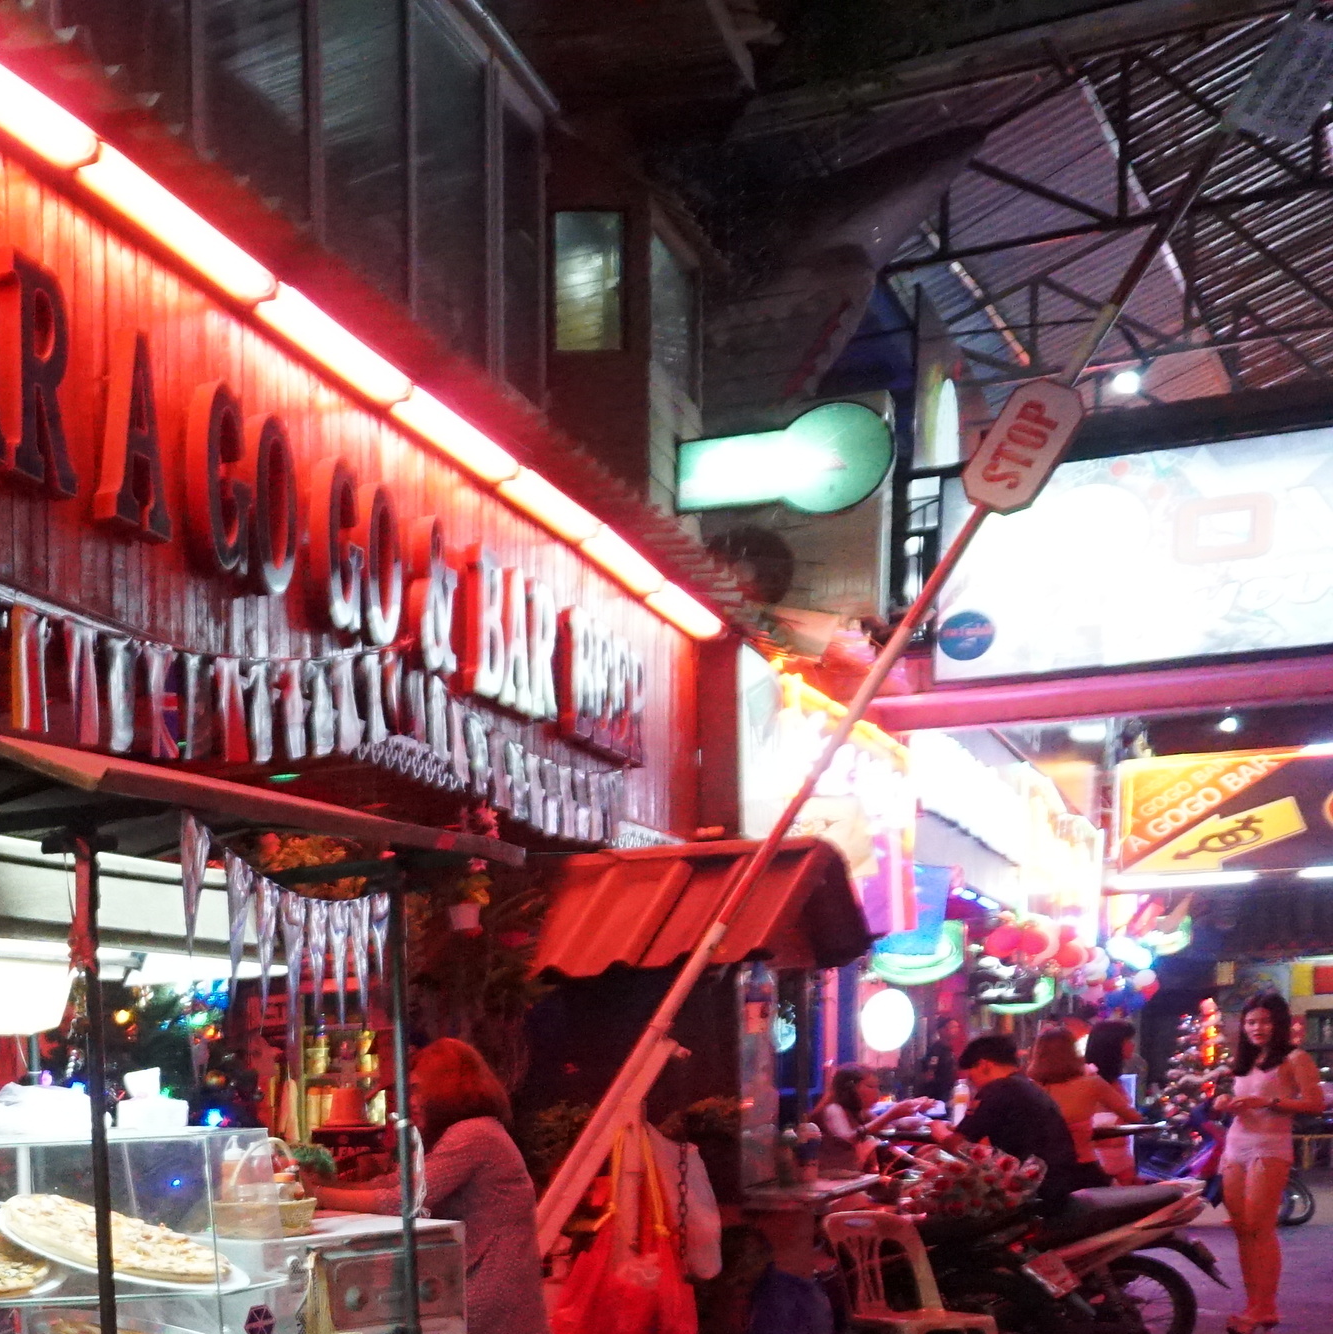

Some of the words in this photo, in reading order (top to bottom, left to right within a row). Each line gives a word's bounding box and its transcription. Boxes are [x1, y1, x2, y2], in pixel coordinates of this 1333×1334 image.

[981, 397, 1059, 490] STOP
[101, 330, 172, 543] A
[191, 380, 298, 594] GO
[313, 458, 403, 645] GO
[459, 545, 559, 722] BAR
[1146, 786, 1223, 837] GOGO
[1218, 754, 1281, 792] BAR
